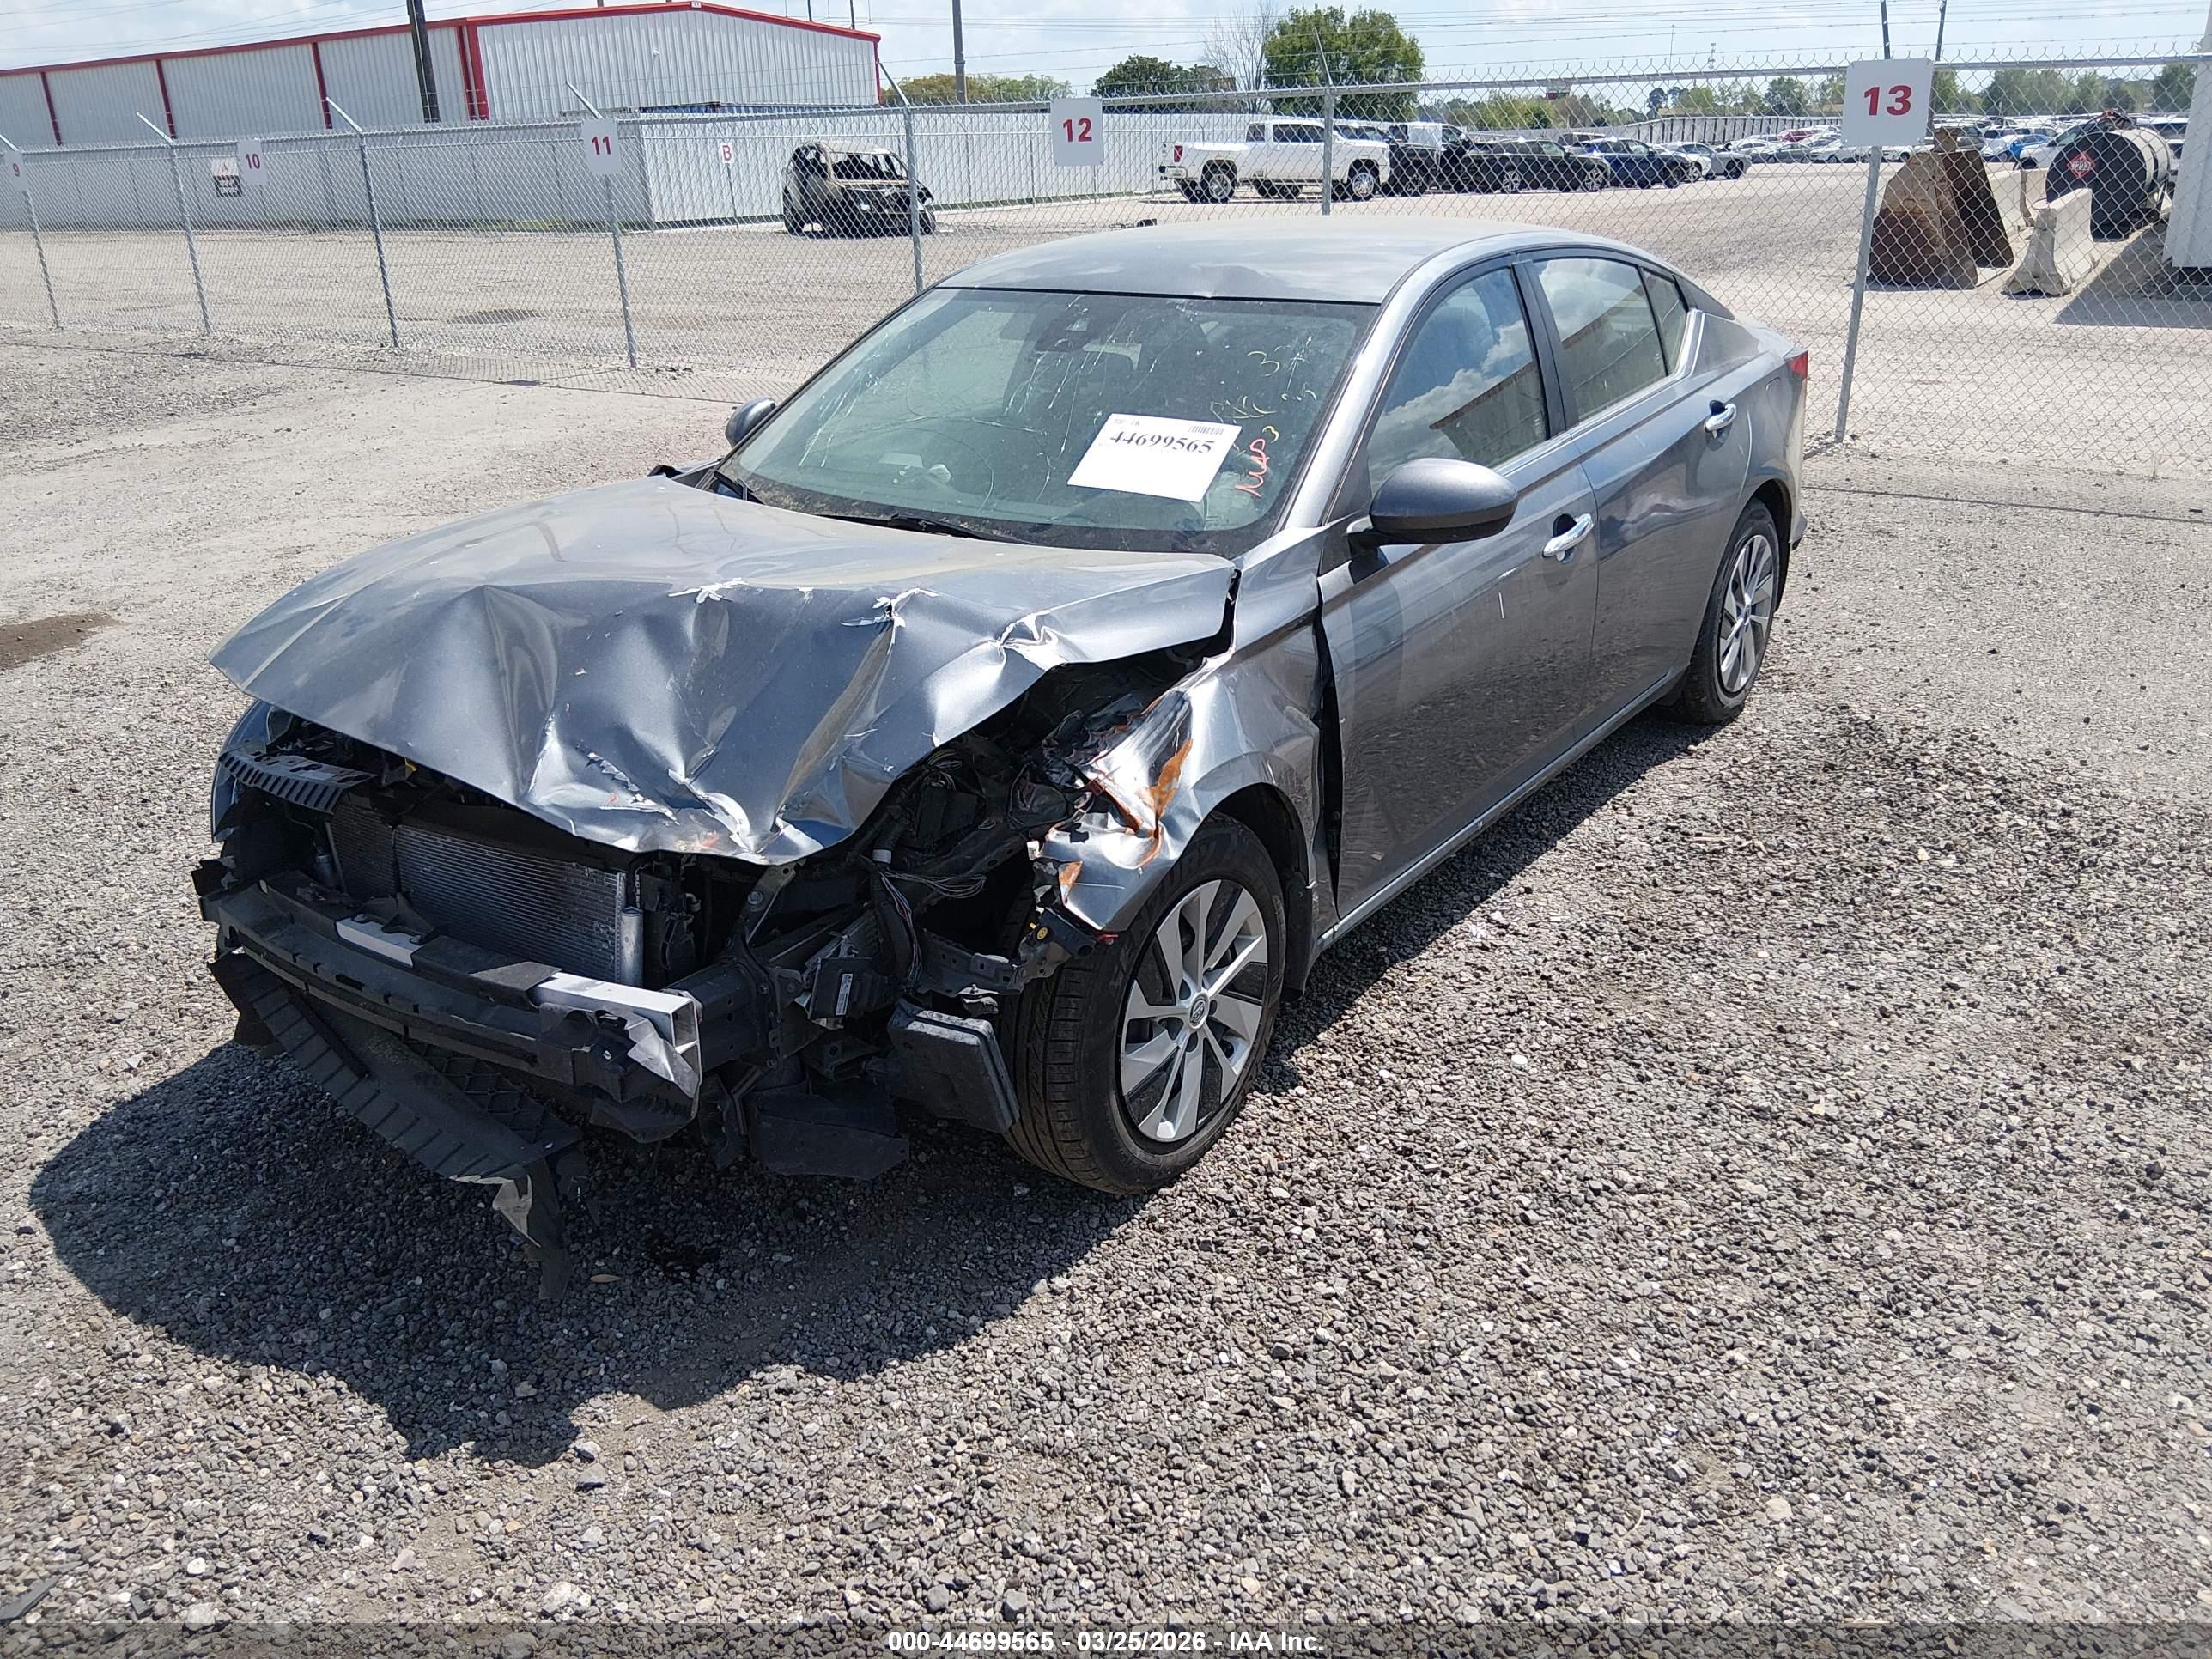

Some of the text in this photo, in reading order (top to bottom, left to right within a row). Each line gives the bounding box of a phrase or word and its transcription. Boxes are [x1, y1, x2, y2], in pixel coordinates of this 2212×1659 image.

[1863, 84, 1912, 116] 13
[1062, 118, 1093, 143] 12
[591, 135, 611, 155] 11
[722, 144, 732, 161] B
[12, 163, 21, 177] 9
[245, 153, 261, 169] 10
[2074, 161, 2090, 170] 1203
[1109, 431, 1215, 453] 44699565
